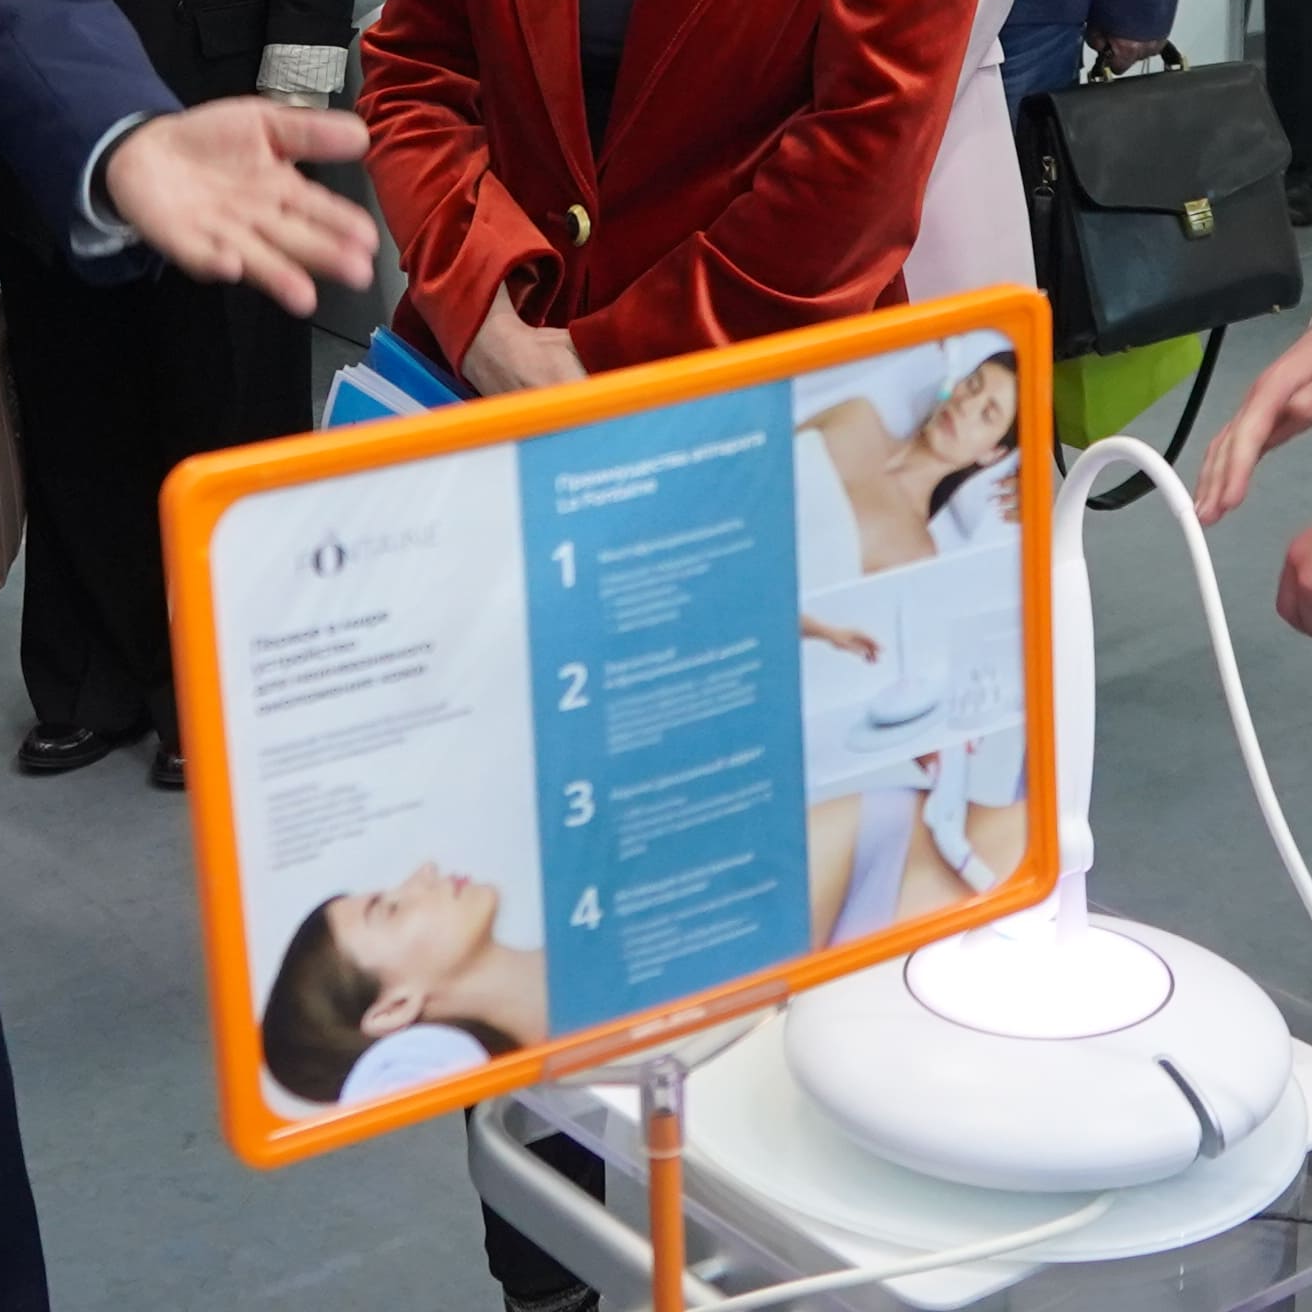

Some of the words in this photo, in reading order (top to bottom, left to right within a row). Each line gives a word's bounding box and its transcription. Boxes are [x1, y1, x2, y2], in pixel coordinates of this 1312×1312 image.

[551, 540, 576, 589] 1
[557, 662, 591, 713] 2
[563, 780, 596, 828] 3
[569, 885, 604, 931] 4
